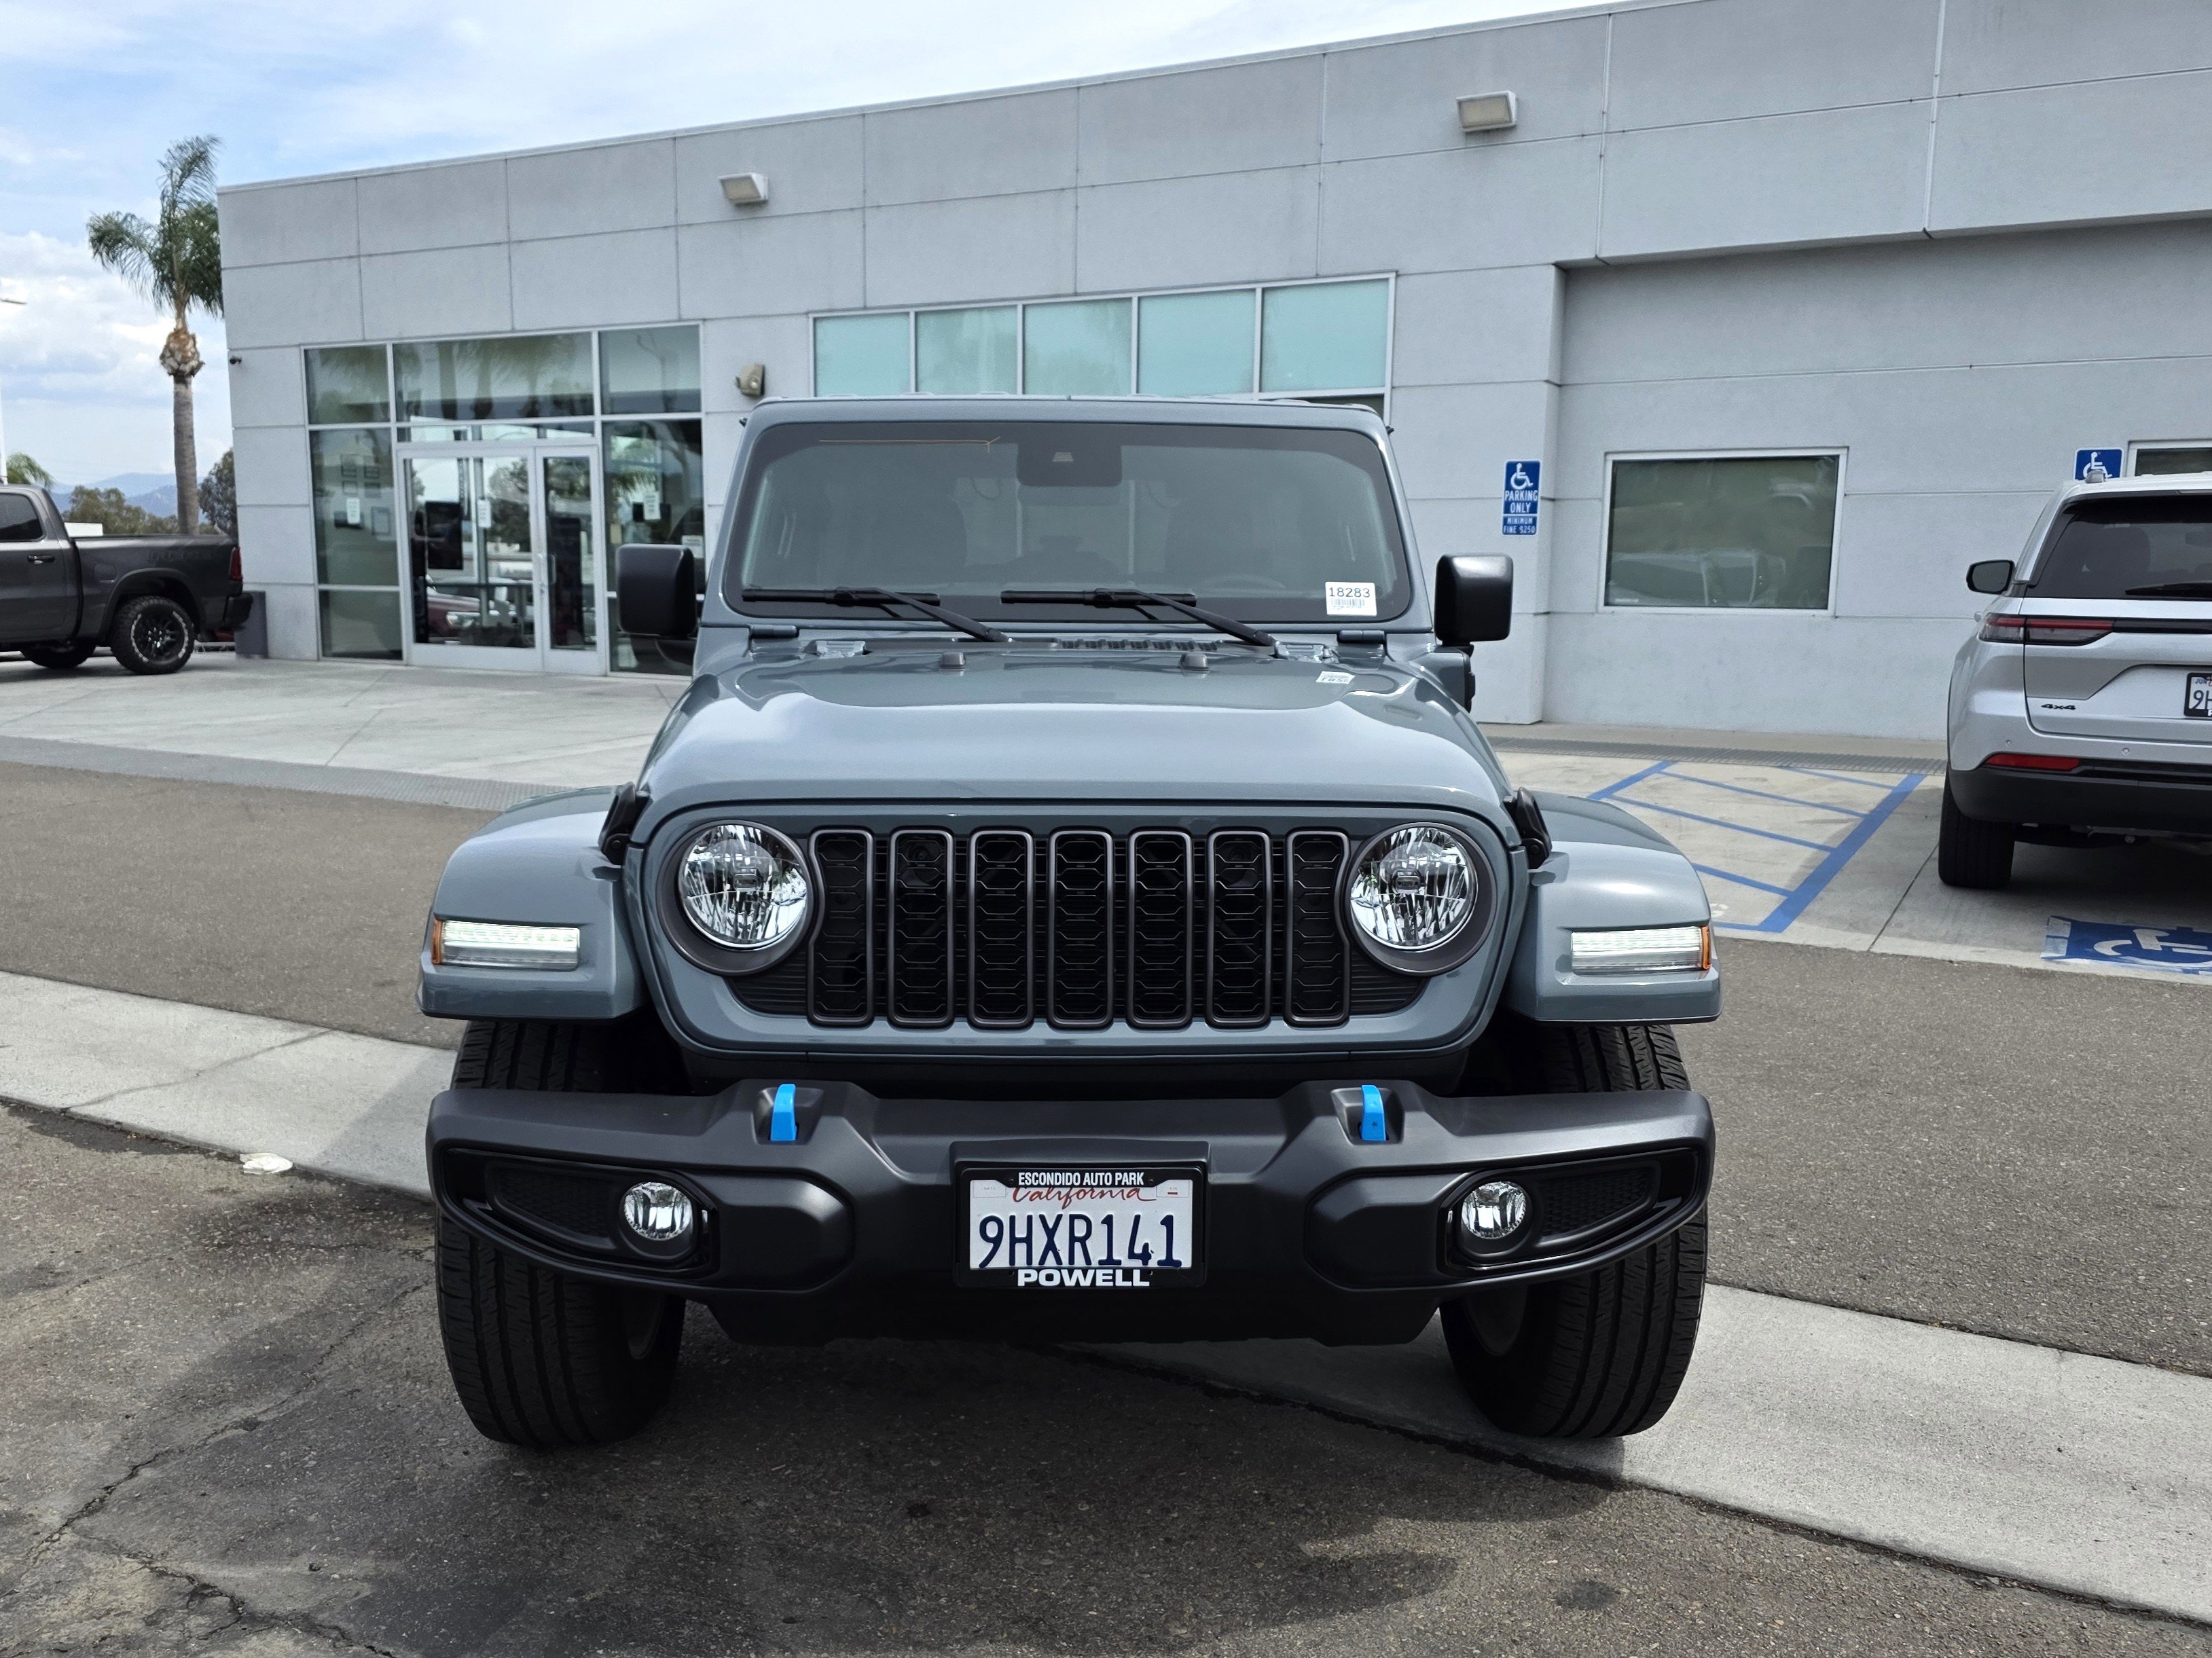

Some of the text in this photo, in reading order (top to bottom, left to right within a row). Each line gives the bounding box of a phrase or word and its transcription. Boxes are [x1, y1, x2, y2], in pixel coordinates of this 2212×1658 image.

[1504, 490, 1538, 502] PARKING
[1510, 502, 1531, 513] ONLY
[1506, 517, 1533, 525] MINIMUM
[1519, 526, 1536, 534] $250
[1328, 587, 1371, 598] 18283
[1018, 1172, 1144, 1185] ESCONDIDO AUTO PARK
[1012, 1187, 1157, 1209] California
[979, 1213, 1182, 1268] 9HXR141
[1017, 1268, 1150, 1287] POWELL
